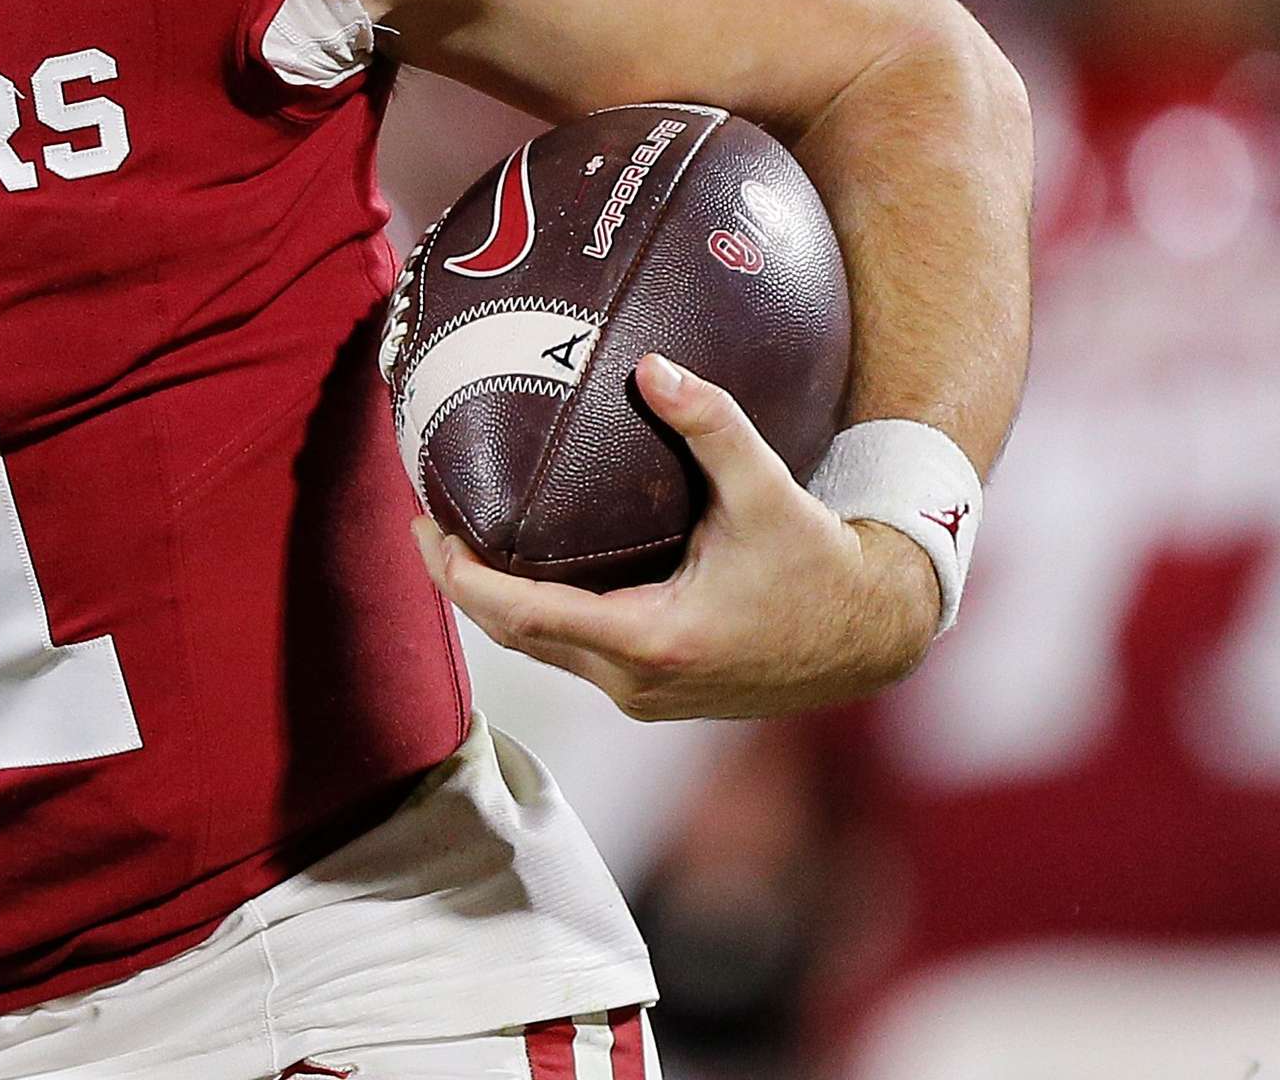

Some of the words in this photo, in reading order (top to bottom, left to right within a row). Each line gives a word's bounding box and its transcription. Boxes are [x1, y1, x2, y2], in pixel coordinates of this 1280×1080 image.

[582, 165, 650, 259] VAPOR
[631, 119, 688, 167] ELITE
[708, 229, 765, 275] OU
